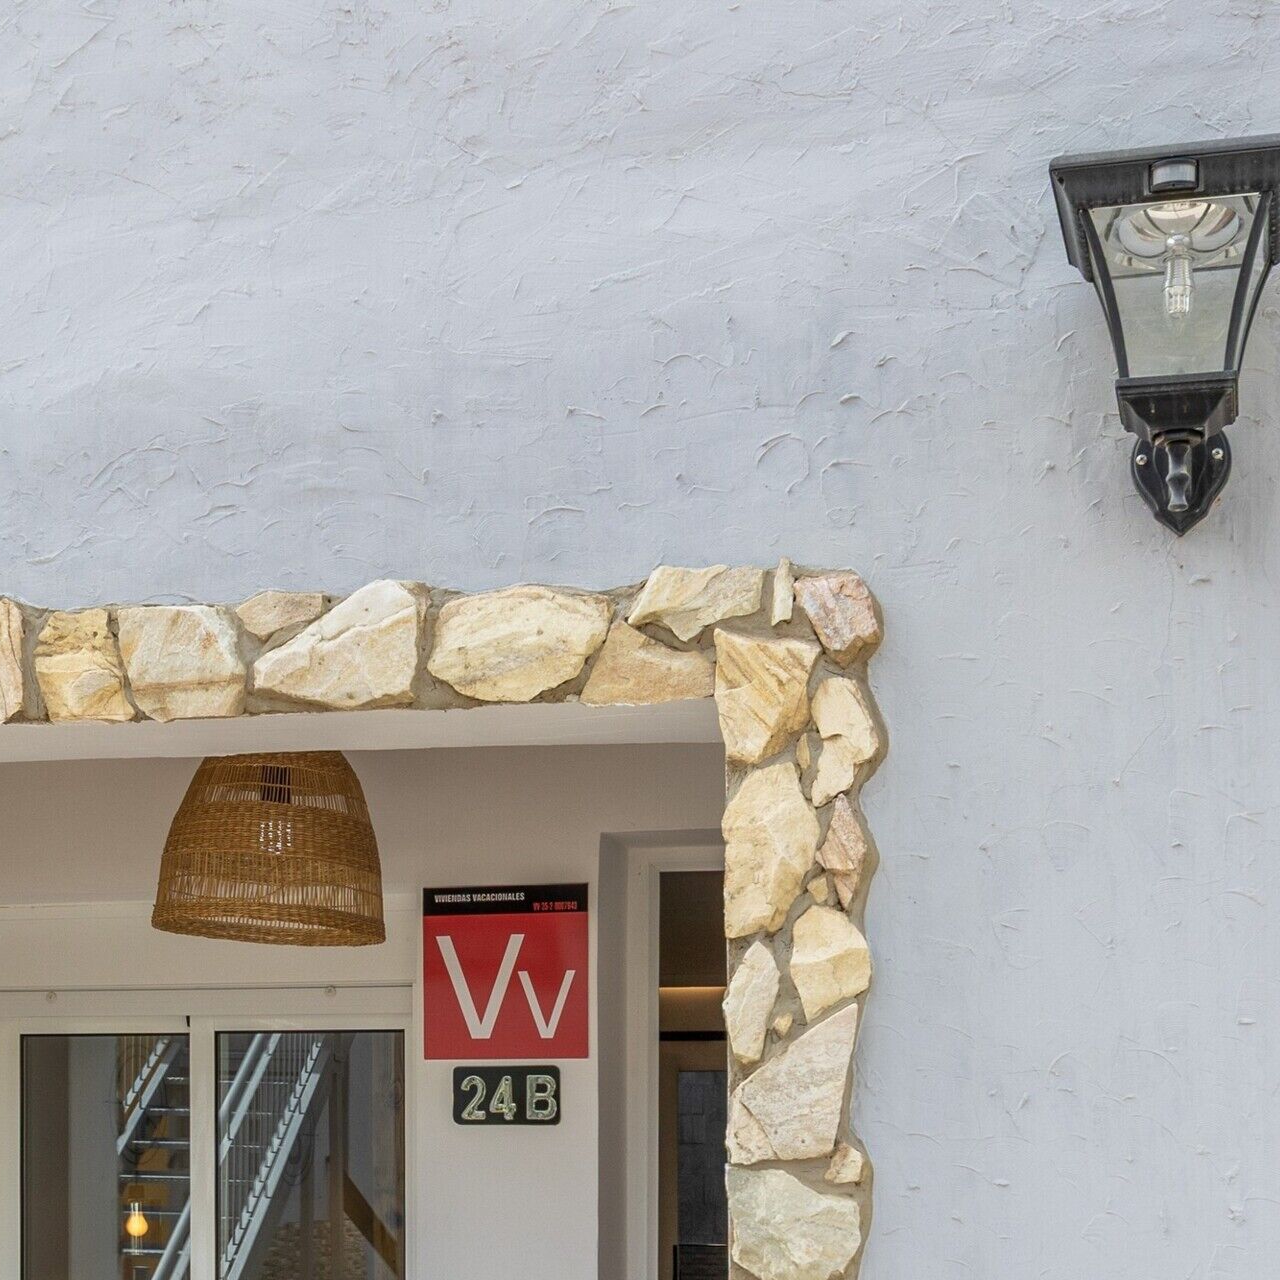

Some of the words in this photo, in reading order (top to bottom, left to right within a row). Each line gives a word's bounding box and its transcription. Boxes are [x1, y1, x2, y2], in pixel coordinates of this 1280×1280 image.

[434, 894, 471, 903] VIVIENDAS
[472, 892, 525, 902] VACACIONALES
[461, 1075, 558, 1120] 24B
